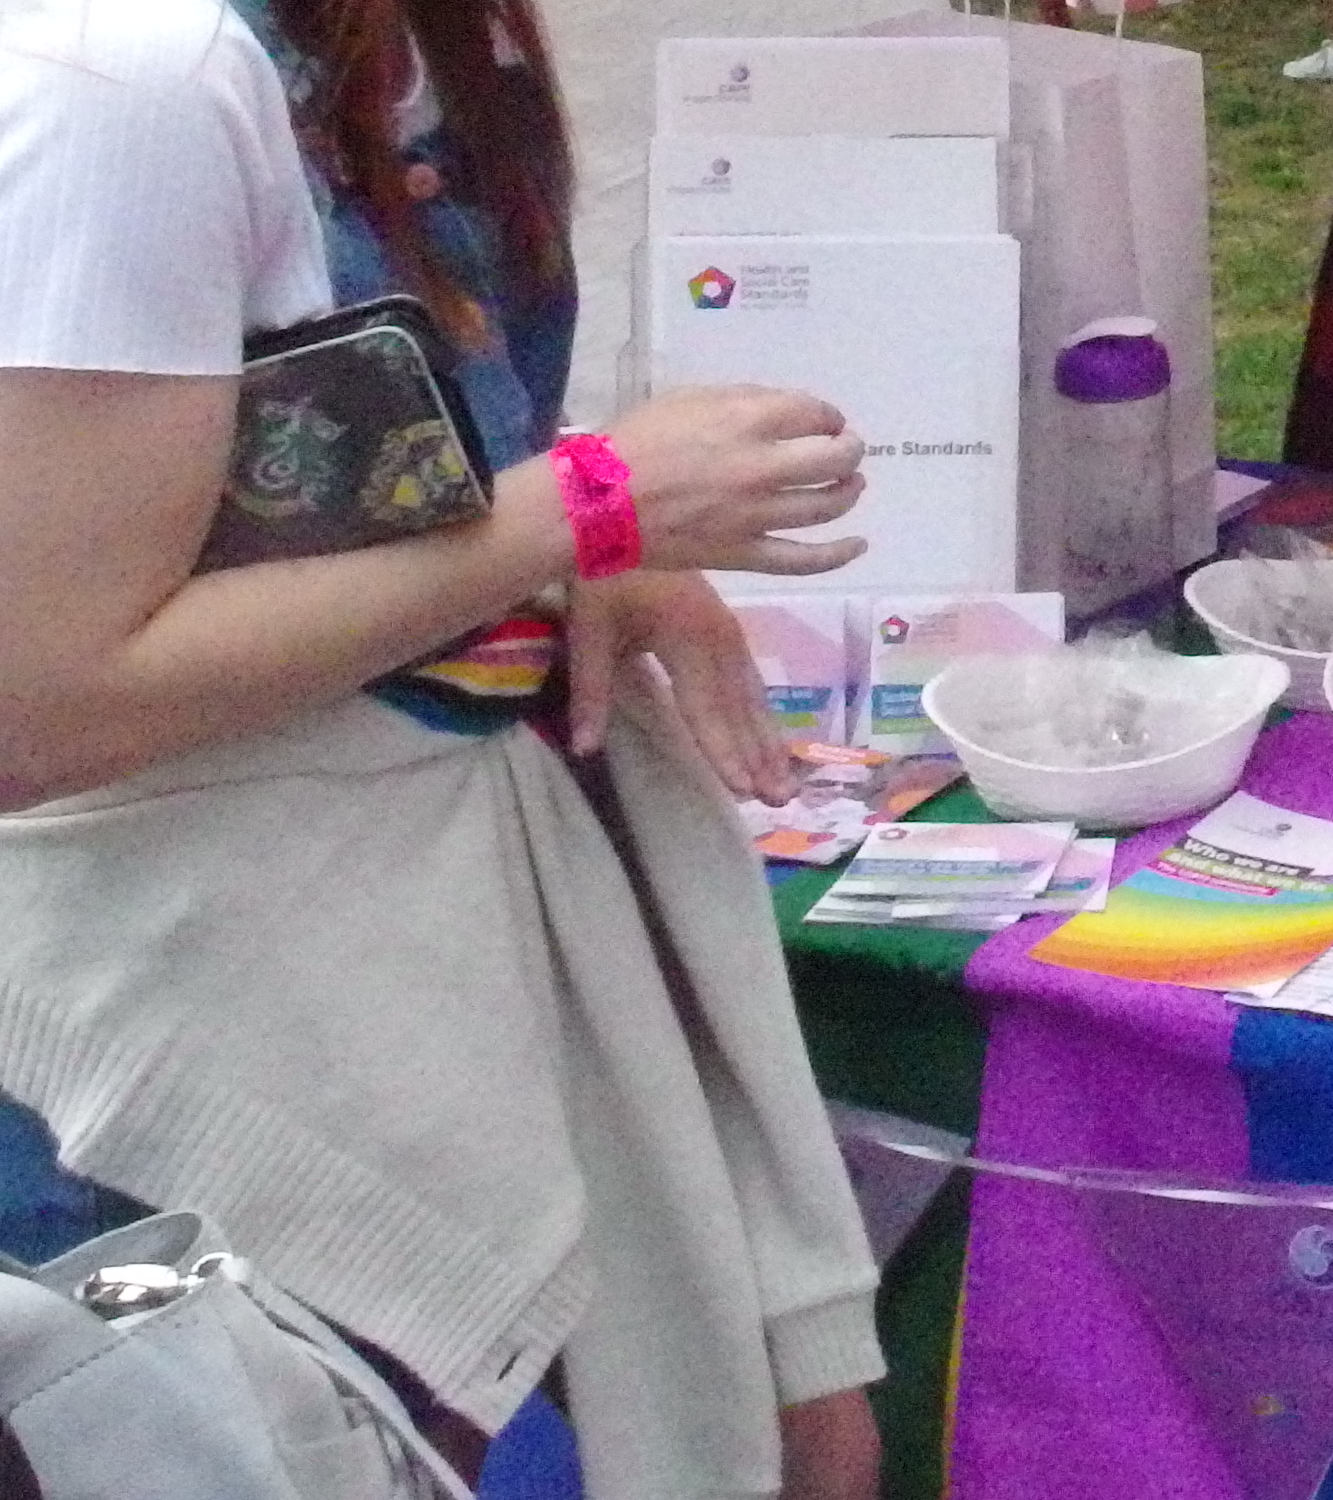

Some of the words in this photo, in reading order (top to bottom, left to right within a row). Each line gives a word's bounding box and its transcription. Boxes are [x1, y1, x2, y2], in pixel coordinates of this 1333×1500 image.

[902, 440, 993, 457] Standards
[1183, 838, 1230, 862] Who
[1232, 856, 1262, 870] we
[1264, 861, 1300, 877] are
